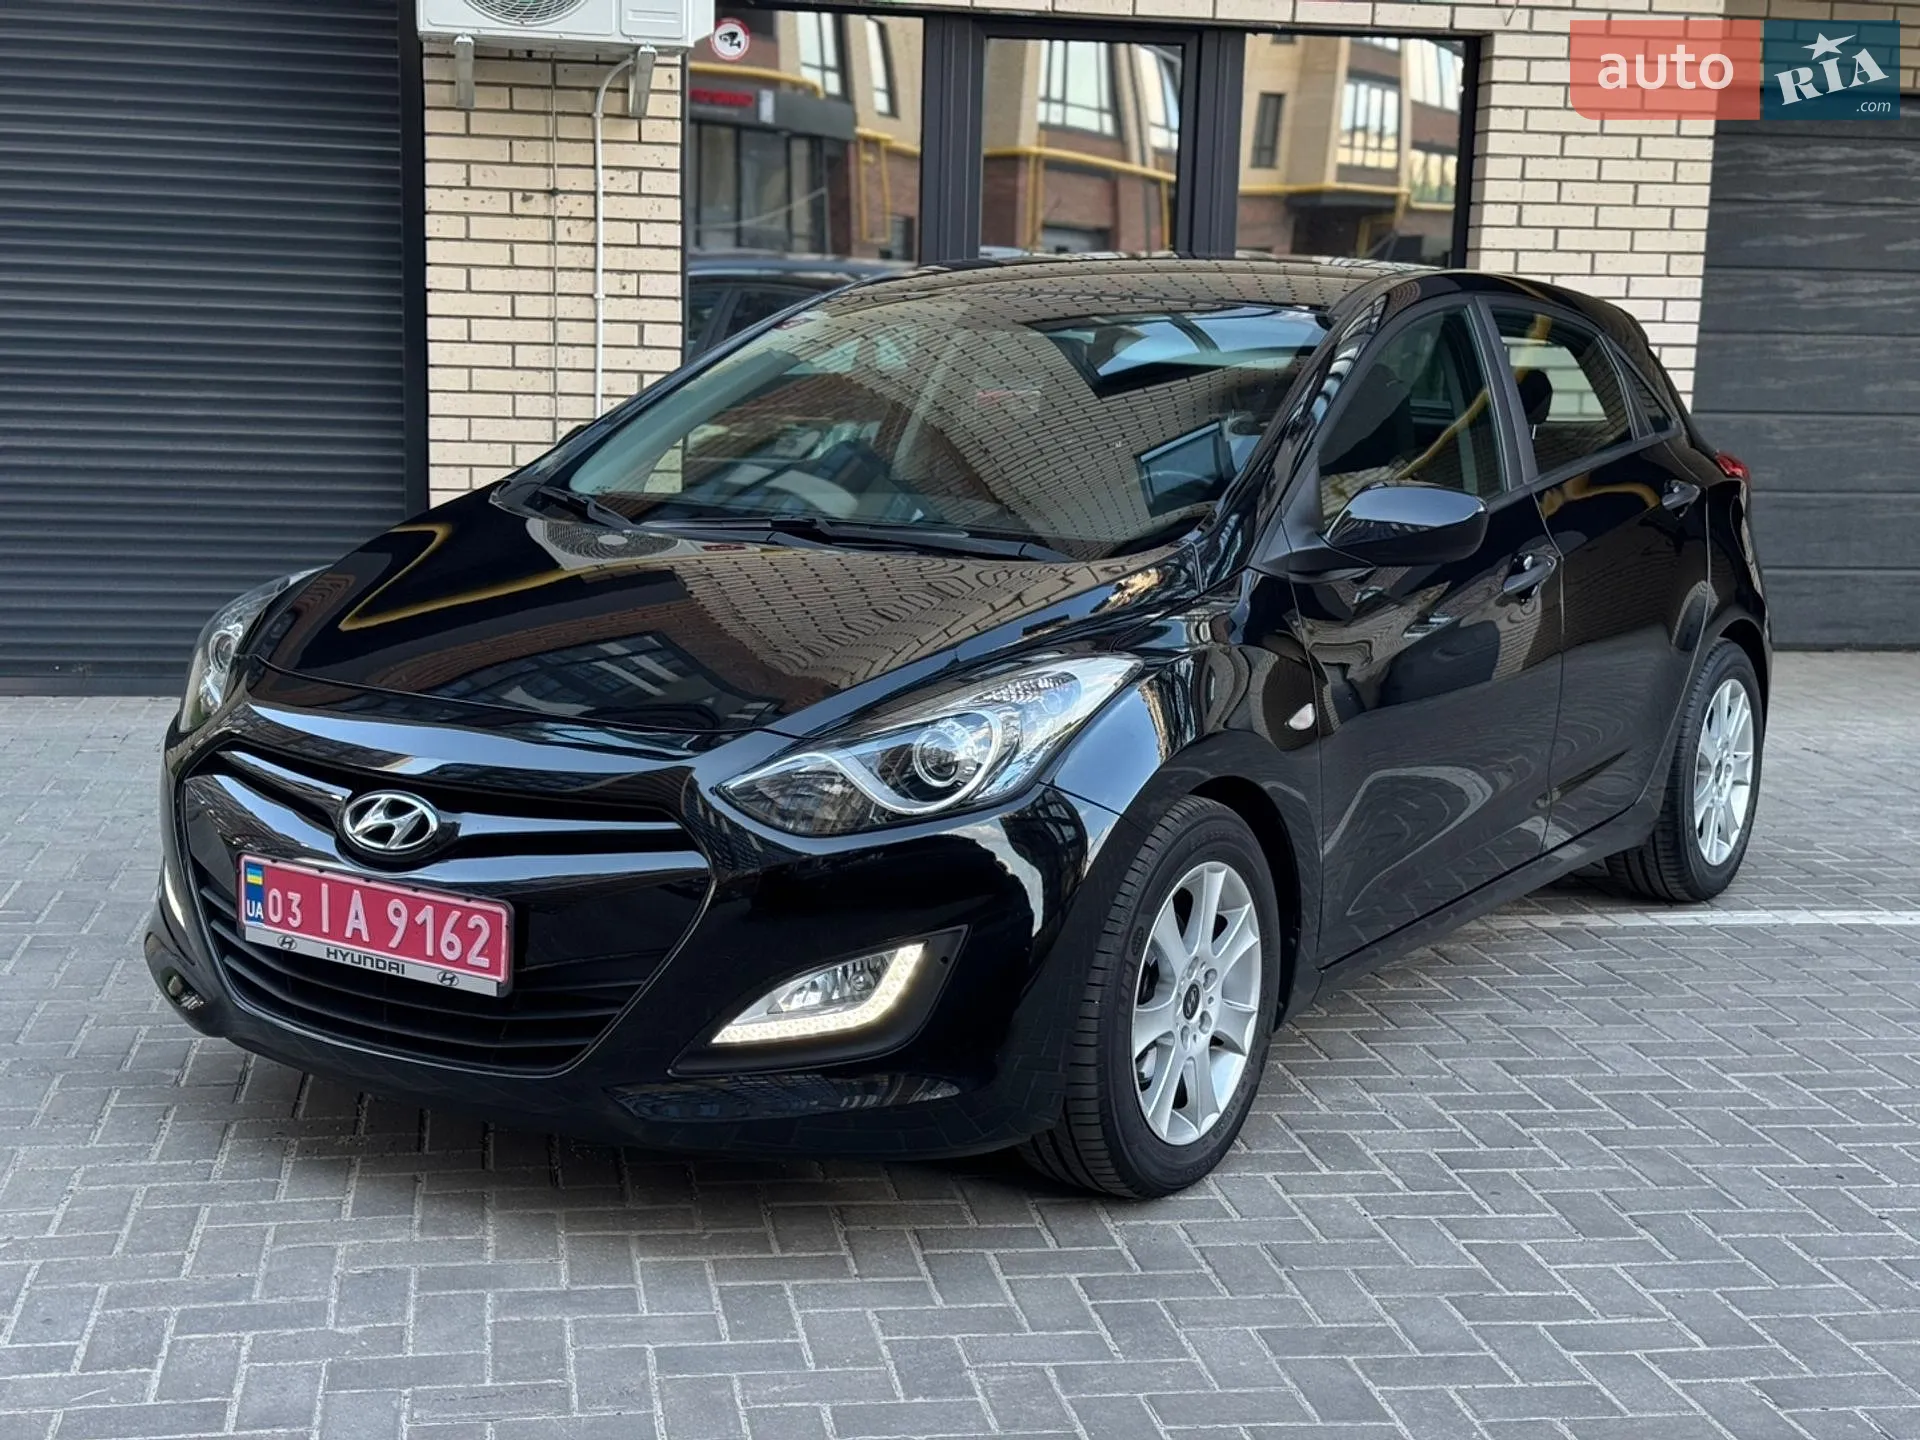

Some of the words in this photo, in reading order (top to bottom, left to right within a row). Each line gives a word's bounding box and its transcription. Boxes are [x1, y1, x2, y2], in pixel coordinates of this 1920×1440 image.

[246, 900, 264, 919] UA
[268, 888, 302, 928] 03
[321, 883, 370, 942] IA
[387, 899, 490, 967] 9162
[326, 948, 406, 976] HYUNDAI
